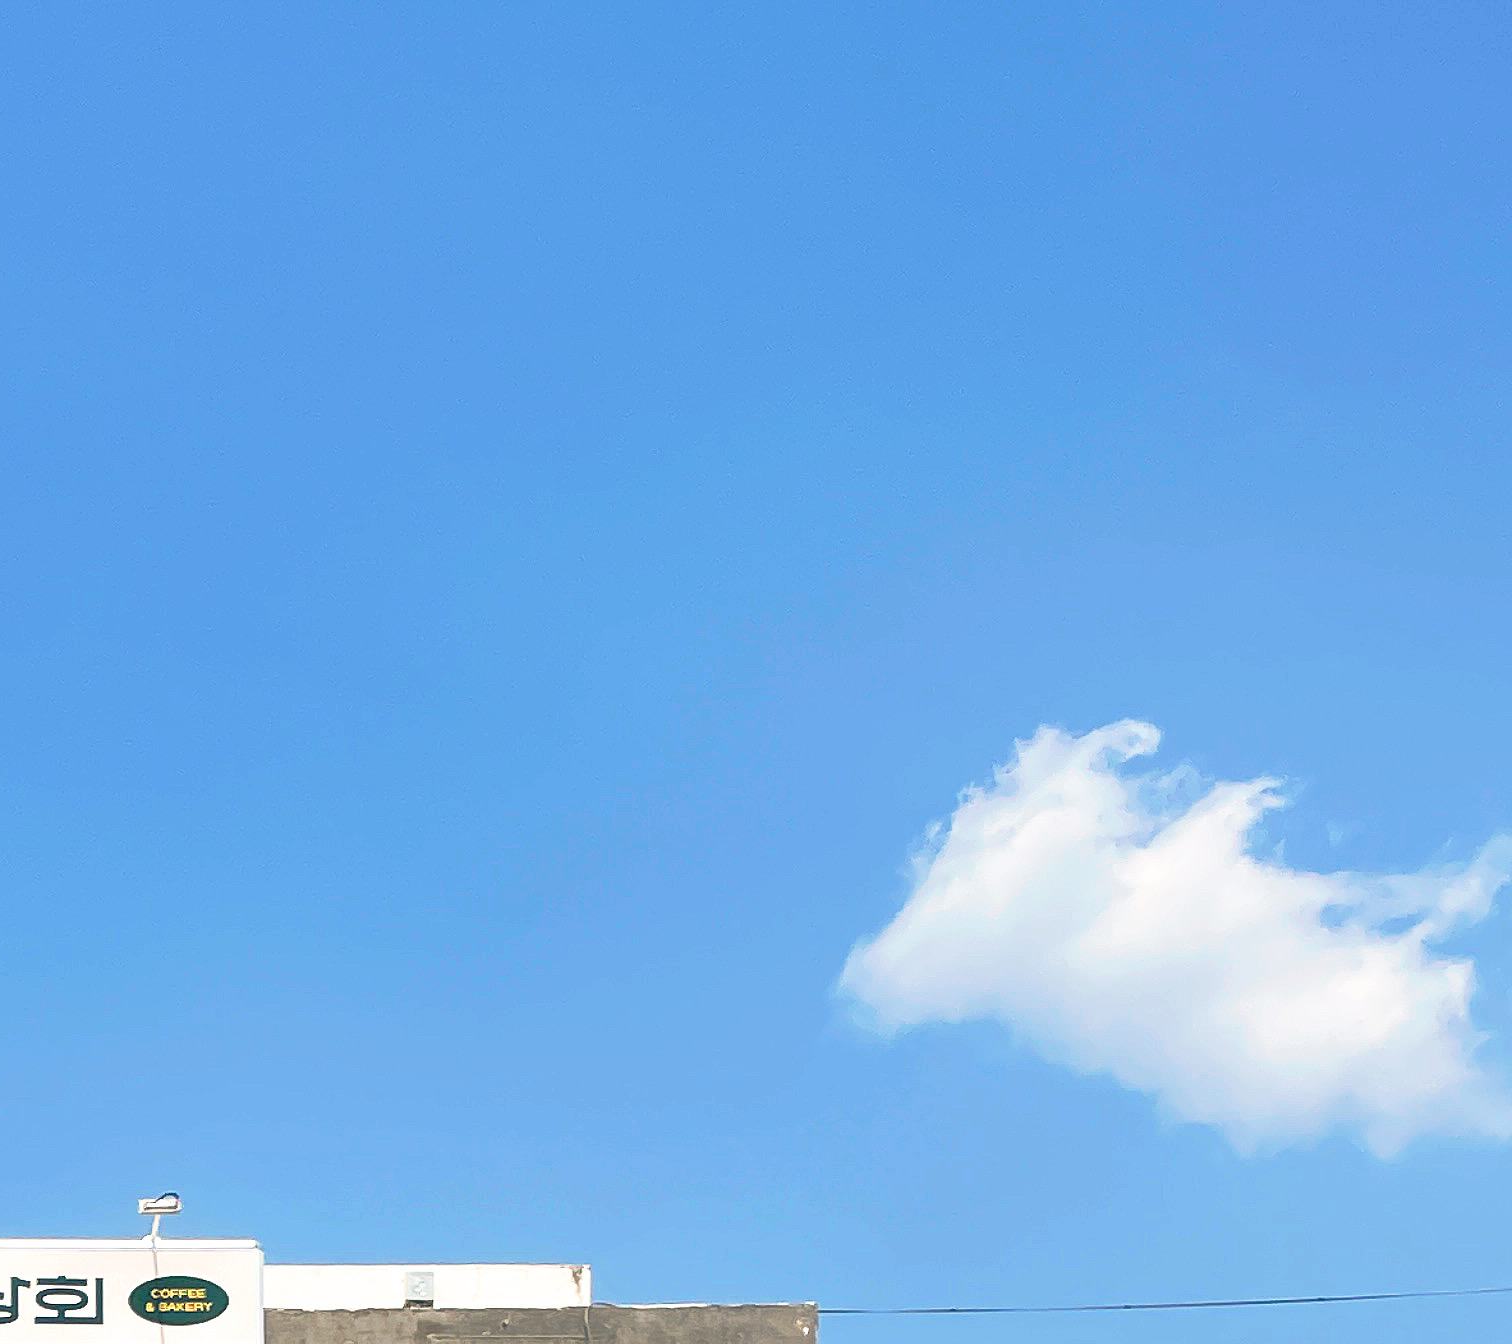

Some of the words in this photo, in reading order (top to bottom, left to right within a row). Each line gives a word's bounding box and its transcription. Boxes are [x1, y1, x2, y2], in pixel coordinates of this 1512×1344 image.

[150, 1287, 207, 1299] COFFEE
[145, 1302, 155, 1313] &
[158, 1302, 213, 1313] BAKERY
